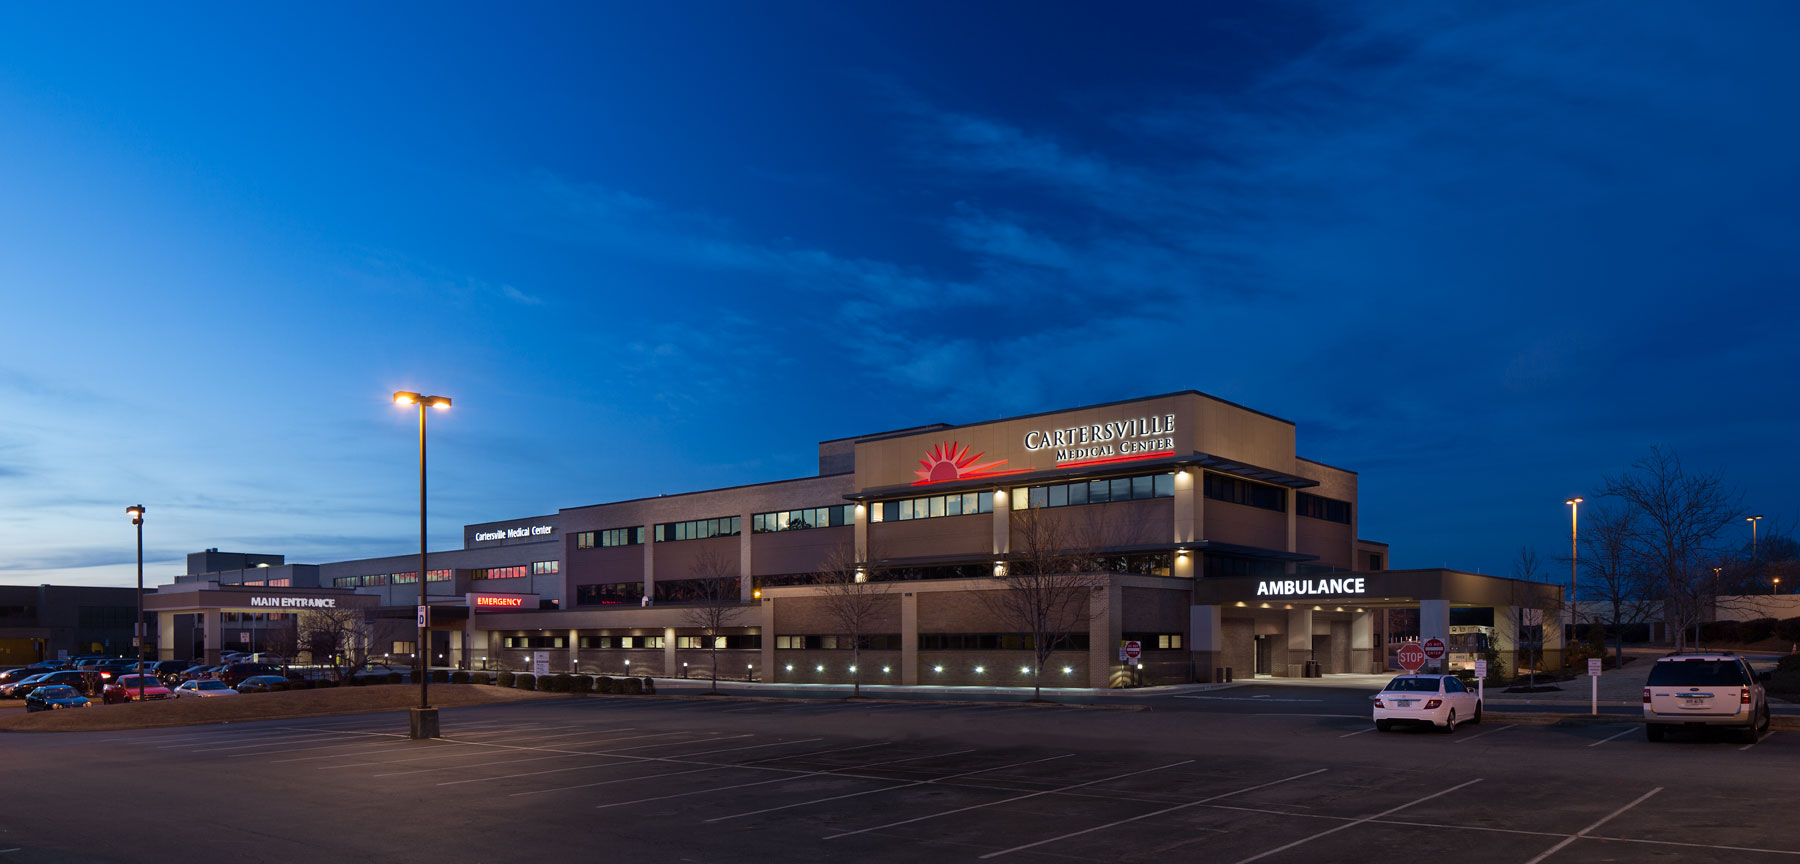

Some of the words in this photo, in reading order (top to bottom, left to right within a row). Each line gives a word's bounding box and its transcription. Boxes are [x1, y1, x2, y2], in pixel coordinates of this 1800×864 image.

[1025, 414, 1175, 450] CARTERSVILLE
[1056, 445, 1114, 461] MEDICAL
[1119, 438, 1175, 453] CENTER
[475, 530, 506, 541] Cartersville
[507, 527, 530, 538] Medical
[531, 525, 552, 535] Center
[1257, 578, 1365, 595] AMBULANCE
[251, 597, 280, 606] MAIN
[281, 597, 336, 608] ENTRANCE
[477, 597, 522, 606] EMERGENCY
[419, 615, 424, 624] D
[1400, 652, 1423, 663] STOP
